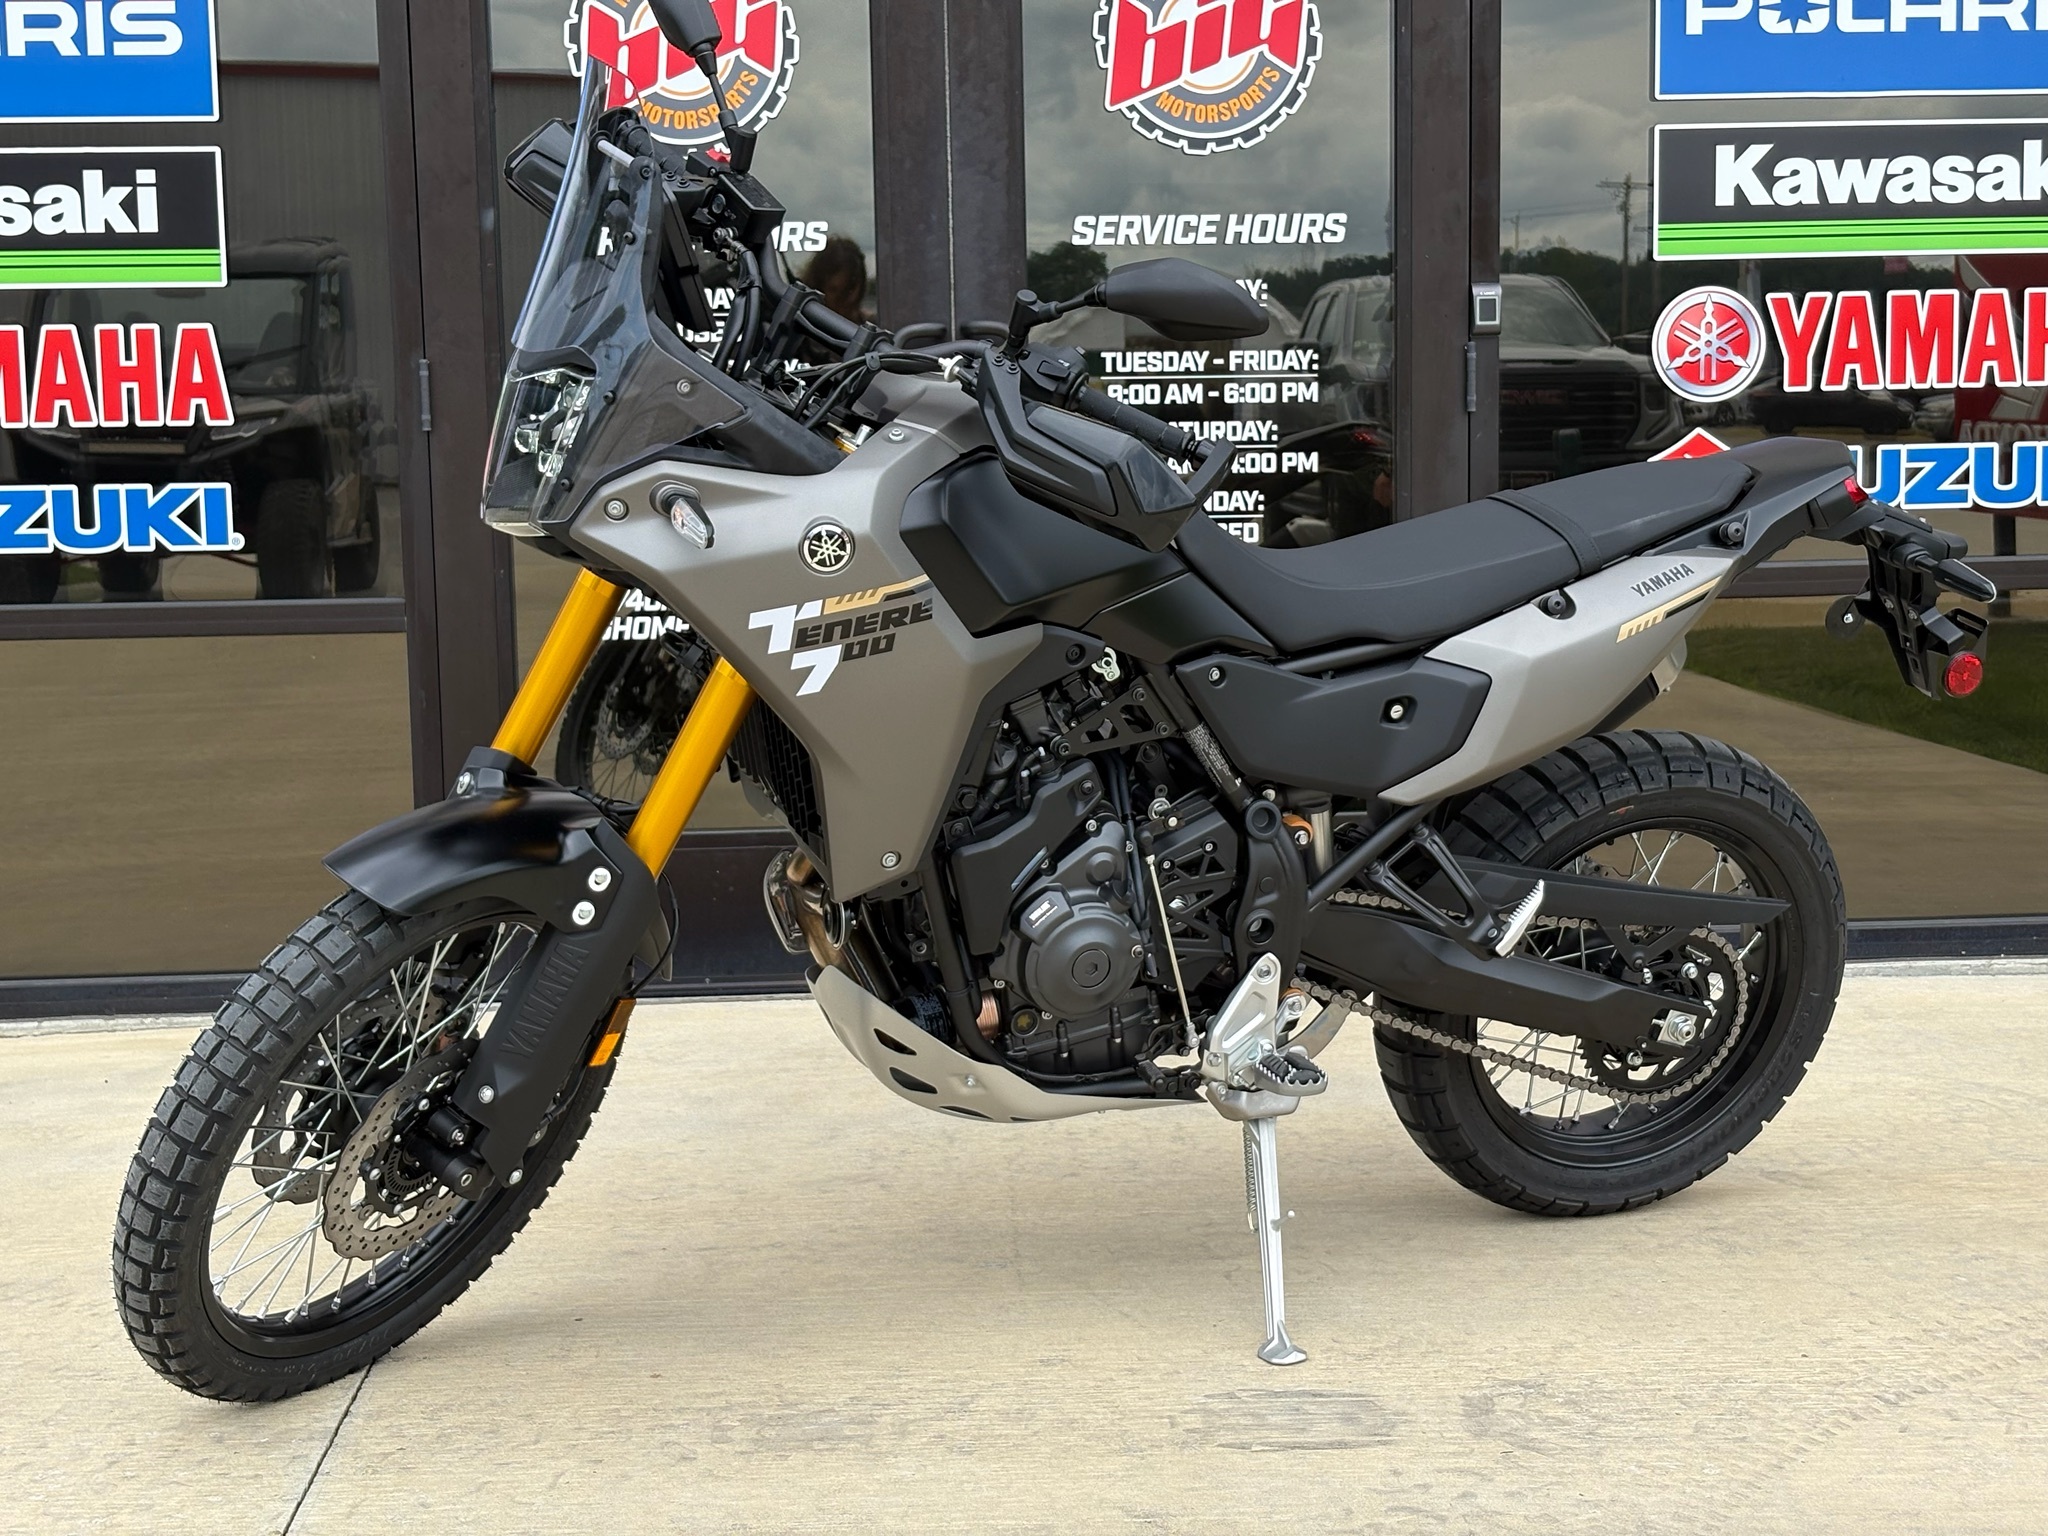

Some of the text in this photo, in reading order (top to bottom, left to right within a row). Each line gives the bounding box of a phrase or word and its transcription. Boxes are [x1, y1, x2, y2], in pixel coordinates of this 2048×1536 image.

[0, 1, 183, 56] RIS
[637, 70, 759, 130] MOTORSPRTS
[1155, 66, 1281, 124] MOTORSPORTS
[1072, 213, 1348, 246] SERVICE HOURS
[1101, 351, 1209, 373] TUESDAY
[1229, 349, 1319, 371] FRIDAY:
[1107, 384, 1161, 405] 9:00
[1164, 383, 1203, 404] AM
[1224, 382, 1277, 404] 6:00
[1281, 382, 1319, 403] PM
[1168, 420, 1279, 442] TURDAY:
[1281, 452, 1319, 473] PM
[1848, 441, 2048, 509] UZU
[1203, 490, 1265, 512] DAY:
[1630, 563, 1695, 598] YAMAHA
[601, 615, 690, 641] HOM
[790, 632, 897, 697] 700
[500, 942, 591, 1059] YAMAHA
